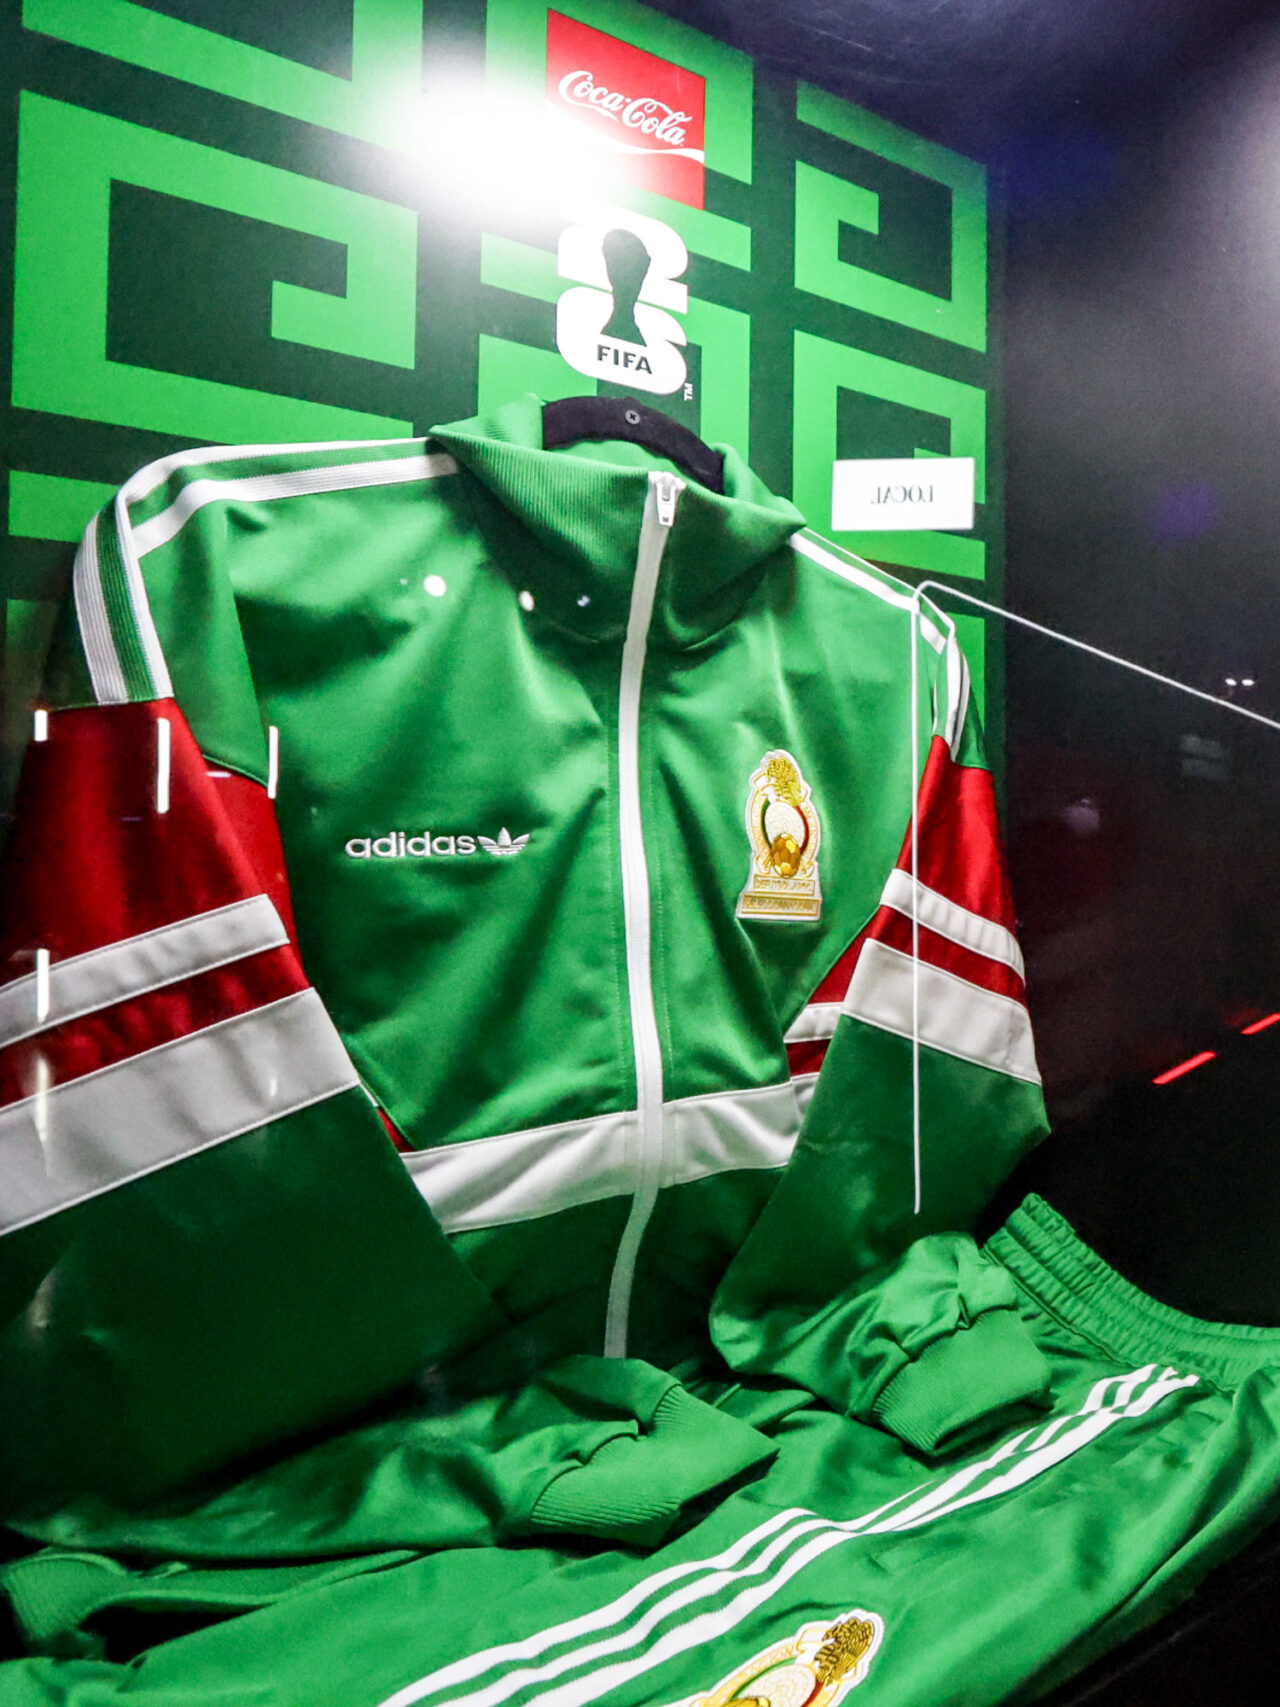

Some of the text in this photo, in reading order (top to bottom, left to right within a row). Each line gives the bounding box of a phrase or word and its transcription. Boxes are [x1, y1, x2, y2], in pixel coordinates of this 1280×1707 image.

[558, 70, 693, 145] Coca-Cola
[597, 344, 652, 375] FIFA
[345, 831, 477, 858] adidas
